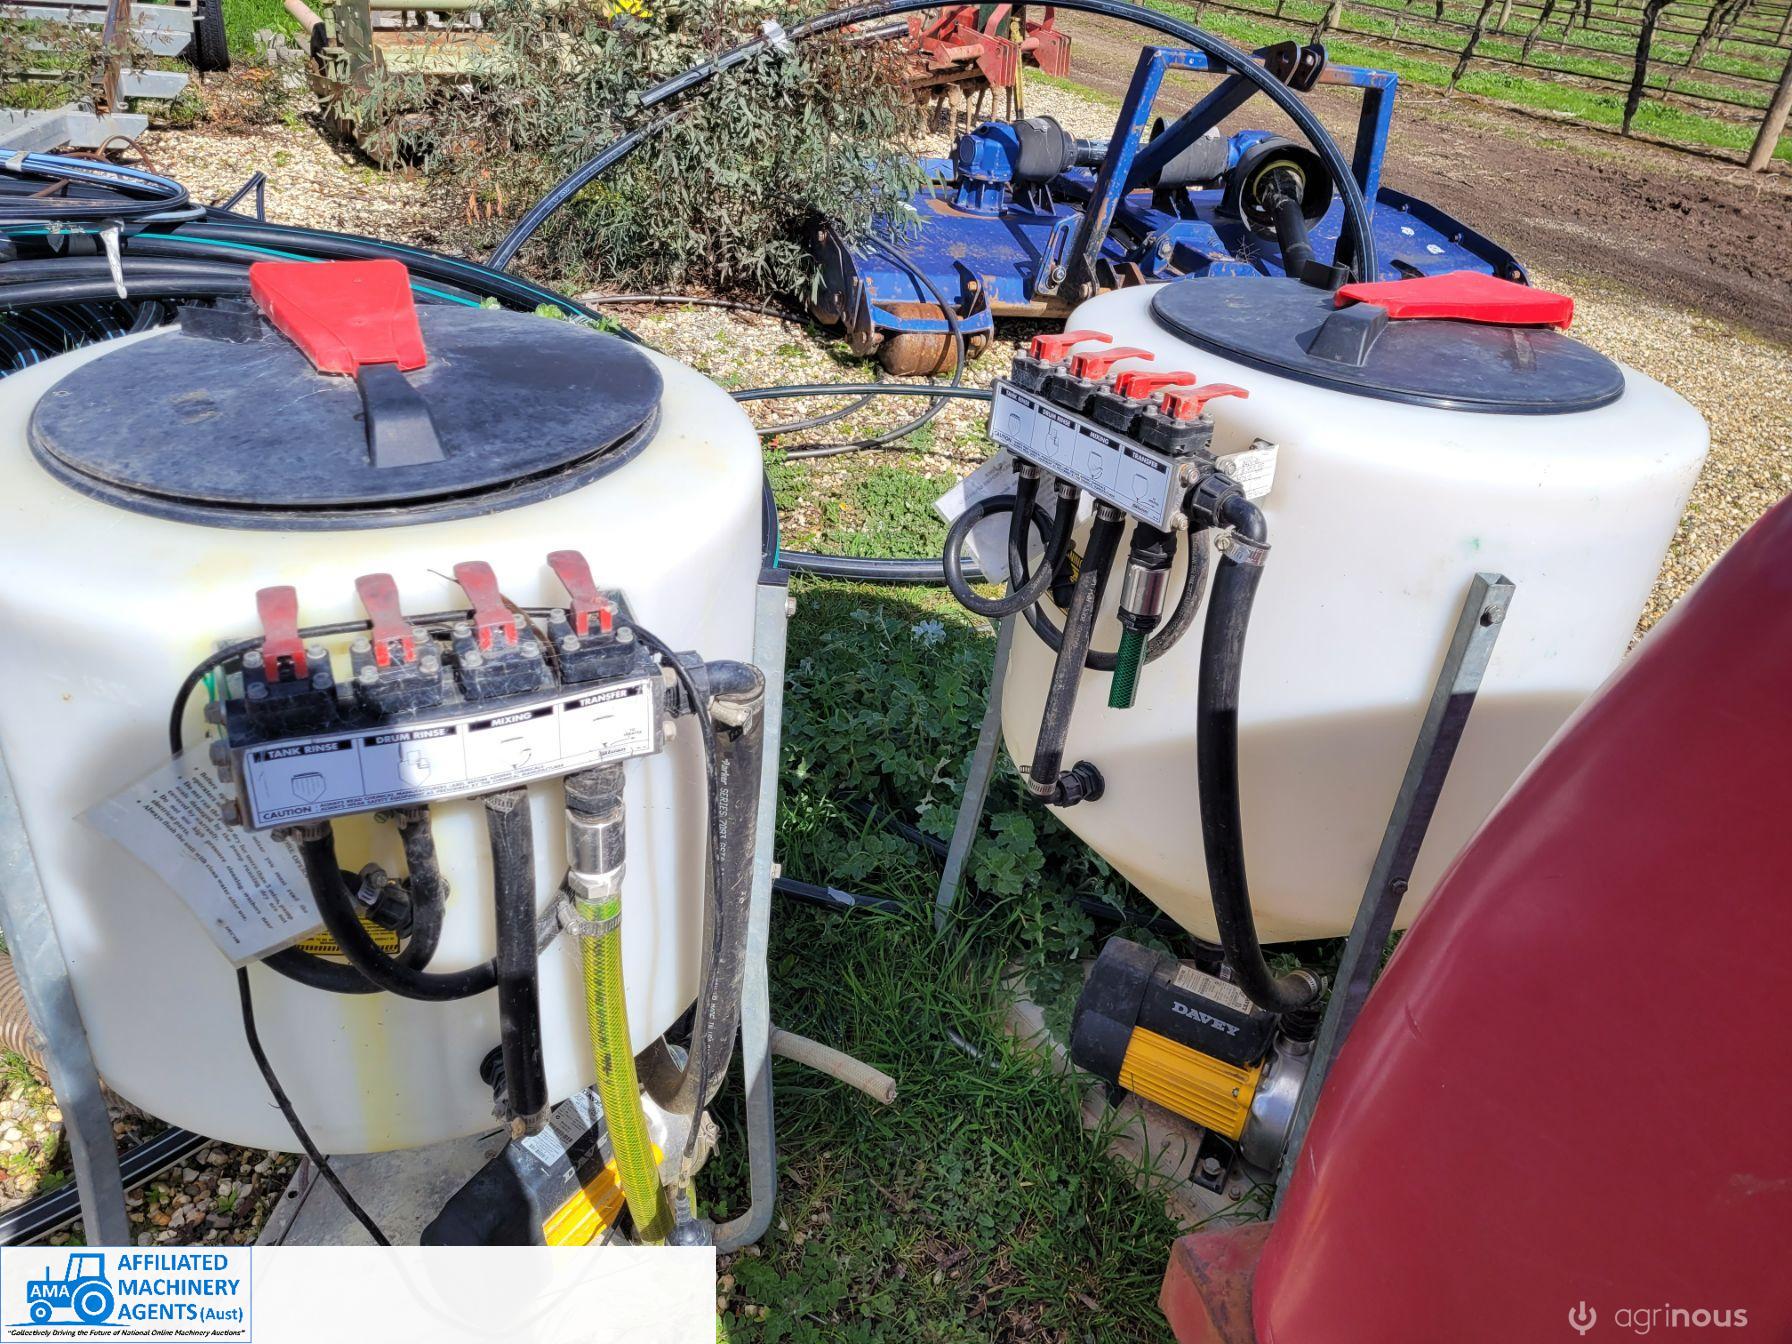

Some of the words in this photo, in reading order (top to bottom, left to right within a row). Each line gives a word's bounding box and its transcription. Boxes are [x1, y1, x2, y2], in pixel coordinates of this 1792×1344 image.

[1042, 409, 1056, 418] DRUM
[1089, 431, 1109, 444] MIXING
[1132, 452, 1159, 468] TRANSFER
[580, 689, 627, 705] TRANSFER
[491, 711, 532, 726] MIXING
[376, 733, 410, 744] DRUM
[413, 727, 446, 738] RINSE
[267, 747, 300, 759] TANK
[305, 742, 338, 754] RINSE
[721, 759, 730, 785] Parker
[719, 787, 728, 816] SERIES
[263, 806, 311, 819] CAUTION
[1172, 1002, 1240, 1037] DAVEY
